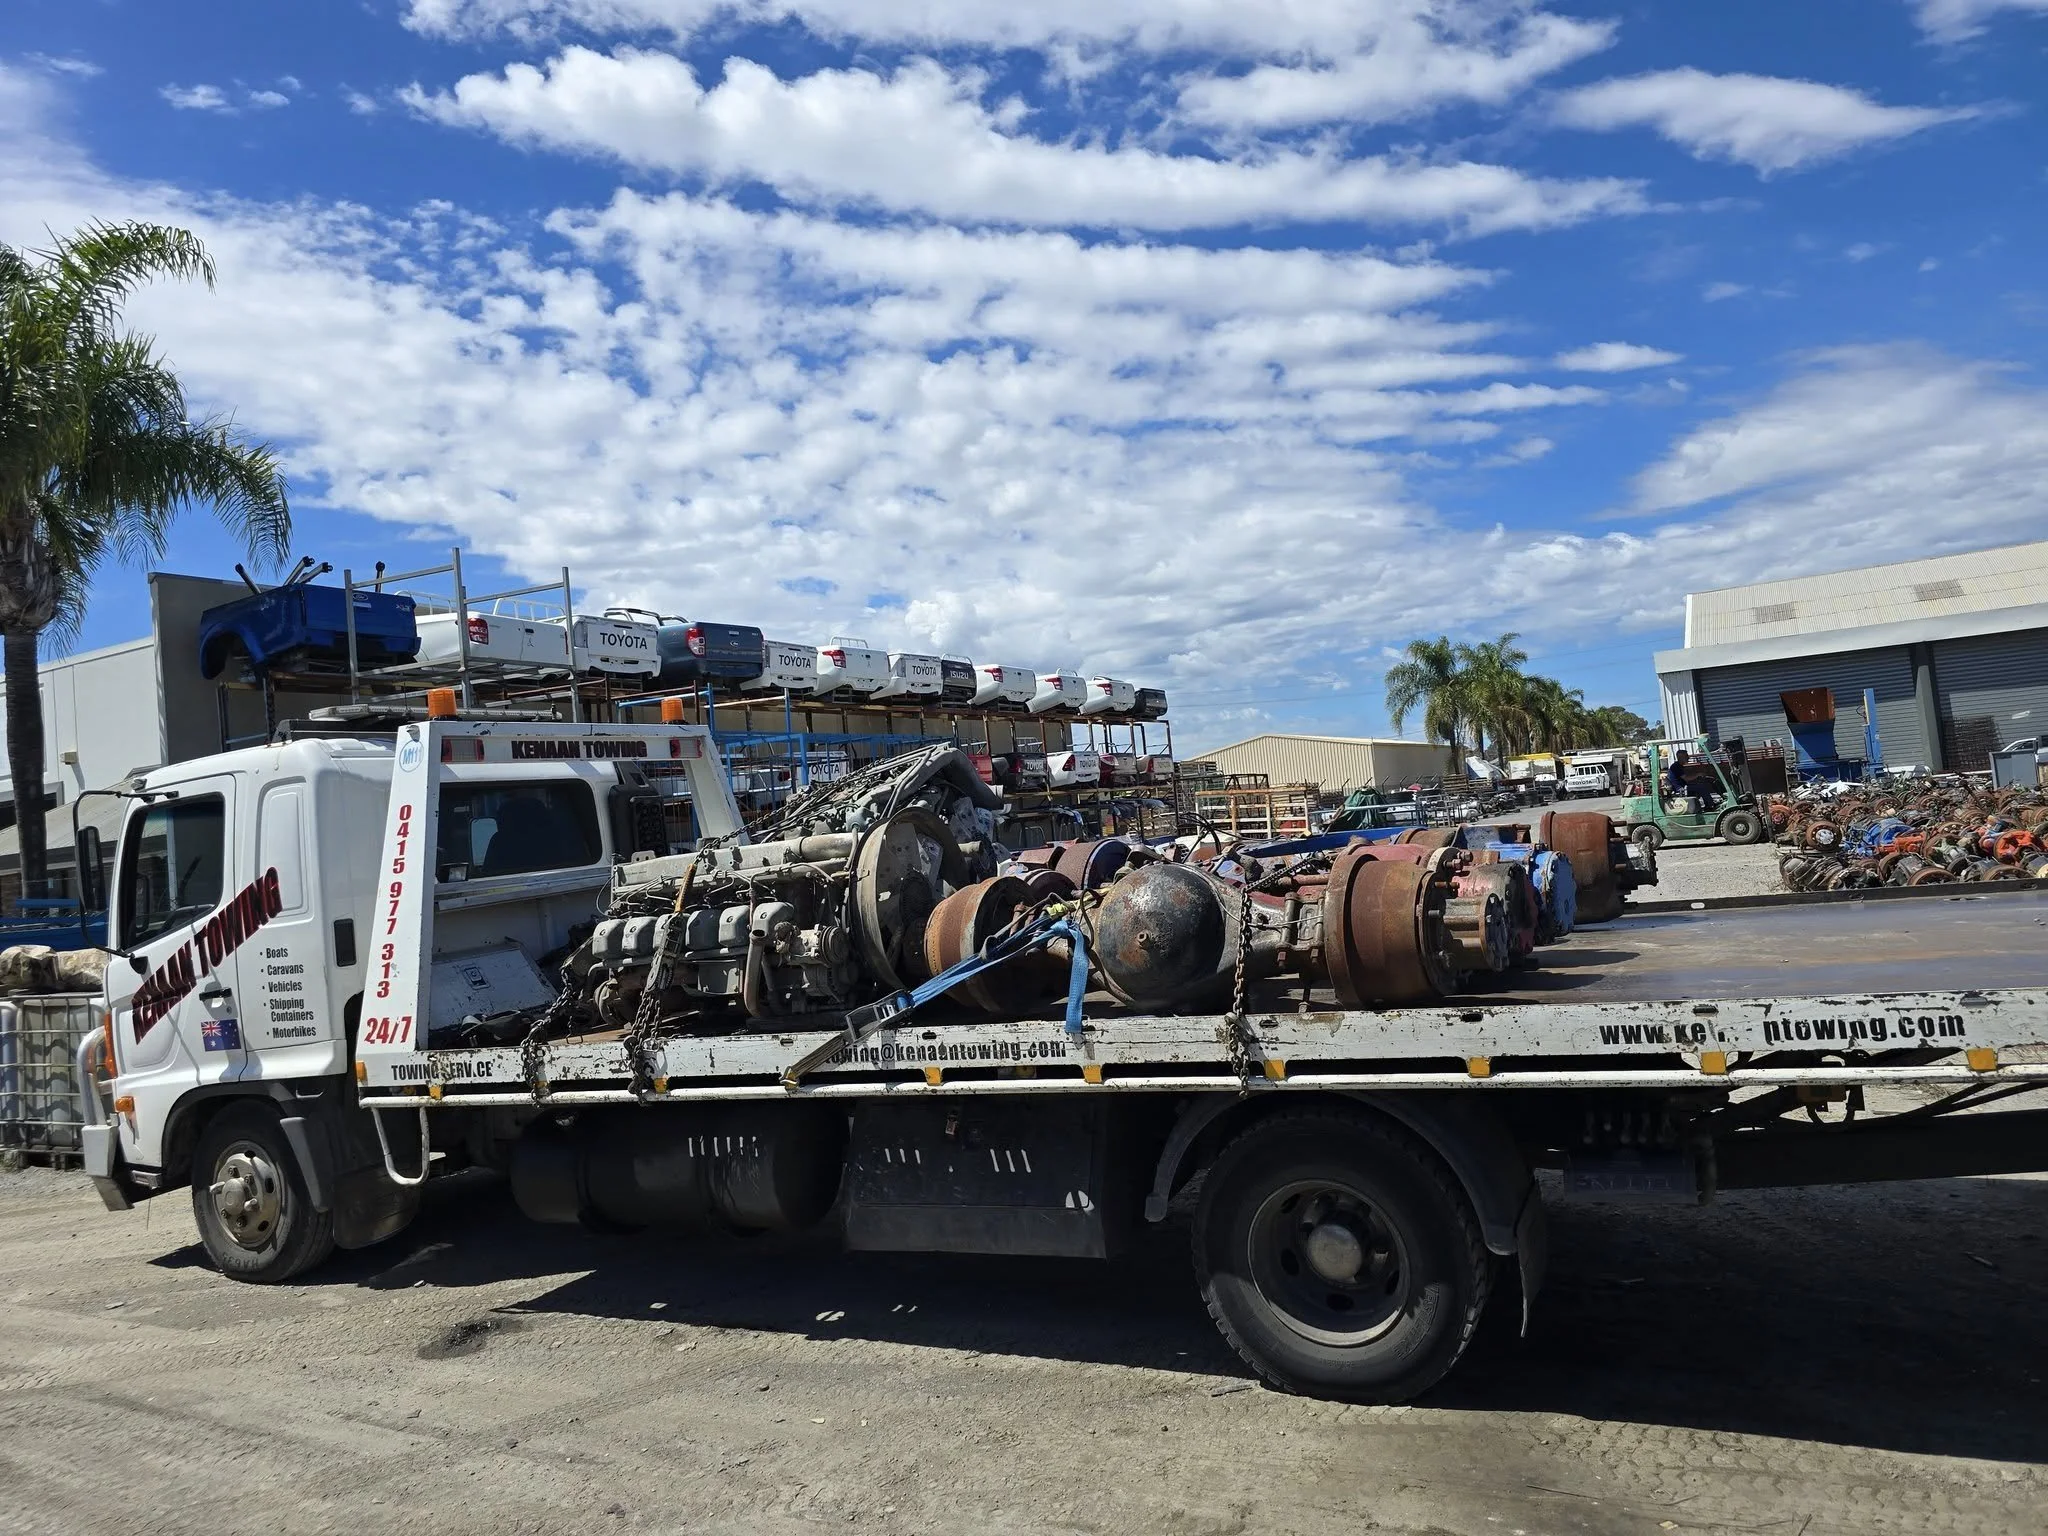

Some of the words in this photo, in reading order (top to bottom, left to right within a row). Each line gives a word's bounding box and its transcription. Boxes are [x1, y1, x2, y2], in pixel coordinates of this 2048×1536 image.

[600, 632, 648, 650] TOYOTA
[778, 653, 811, 669] TOYOTA
[911, 664, 937, 676] TOYOTA
[949, 670, 969, 680] ISUZU
[511, 740, 580, 759] KENAAN
[583, 740, 648, 758] TOWING
[809, 763, 840, 775] OYOTA
[392, 804, 412, 875] 0415
[386, 881, 403, 935] 977
[194, 866, 283, 979] TOWING
[266, 947, 289, 958] Boats
[267, 964, 304, 975] Caravans
[376, 943, 394, 999] 313
[268, 981, 303, 993] Vehicles
[269, 998, 305, 1011] Shipping
[270, 1010, 315, 1022] Containers
[272, 1025, 317, 1038] Motorbikes
[364, 1016, 412, 1045] 24/7
[826, 1039, 1067, 1065] owing@kenaantowing.com
[391, 1061, 438, 1081] TOWING
